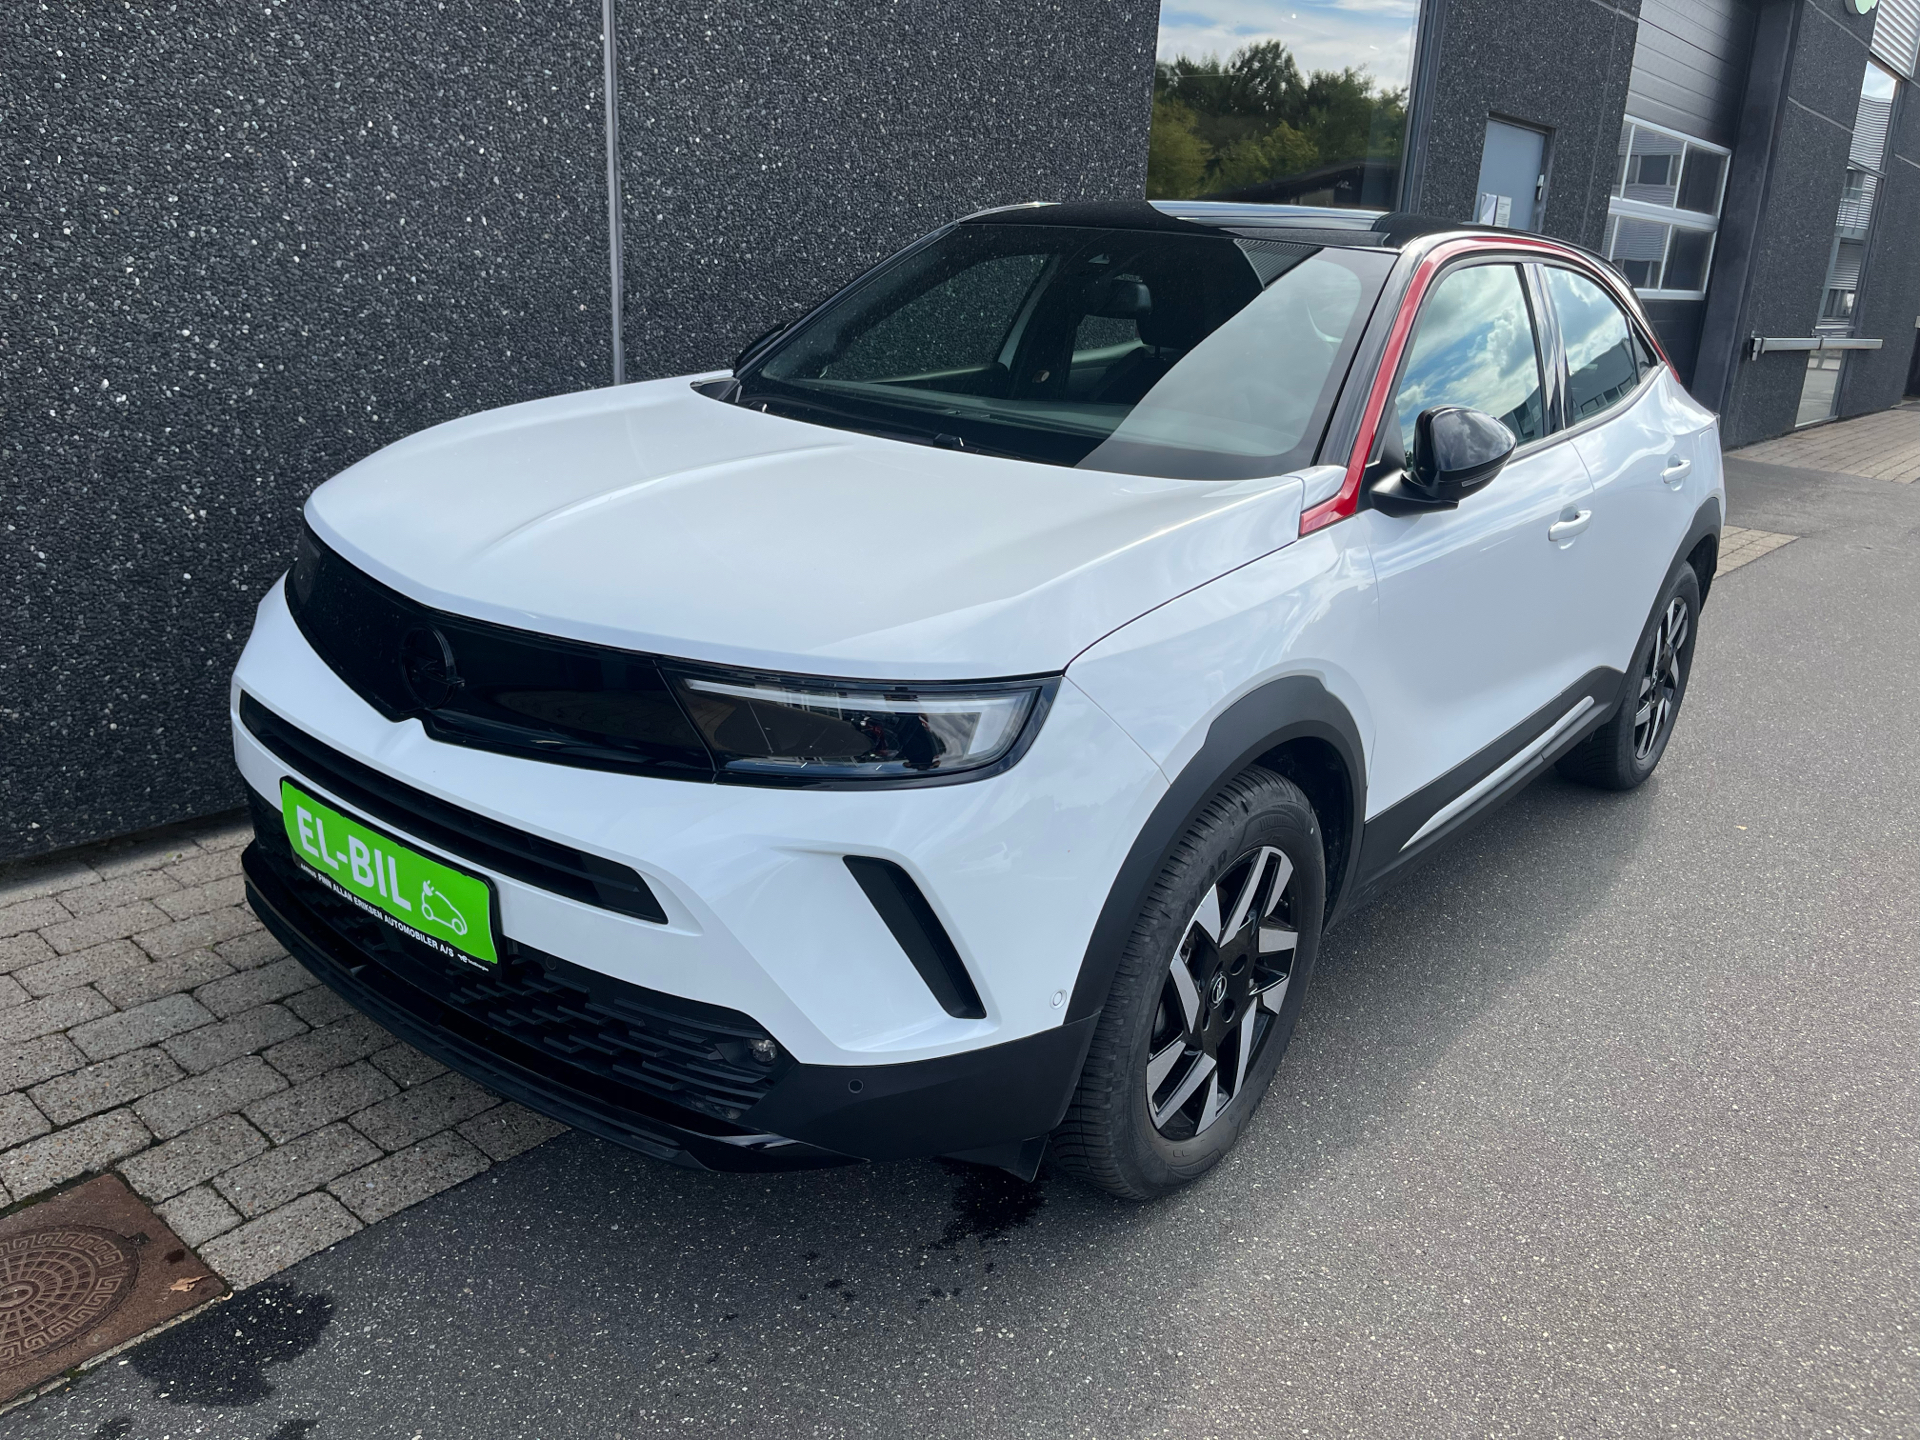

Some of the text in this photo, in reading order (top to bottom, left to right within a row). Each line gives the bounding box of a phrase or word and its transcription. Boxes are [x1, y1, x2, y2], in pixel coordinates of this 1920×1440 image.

[296, 804, 412, 912] EL-BIL
[333, 883, 353, 902] ALLAN
[353, 896, 384, 920] ERIKSEN
[384, 914, 438, 950] AUTOMOBILER
[440, 944, 454, 957] A/S
